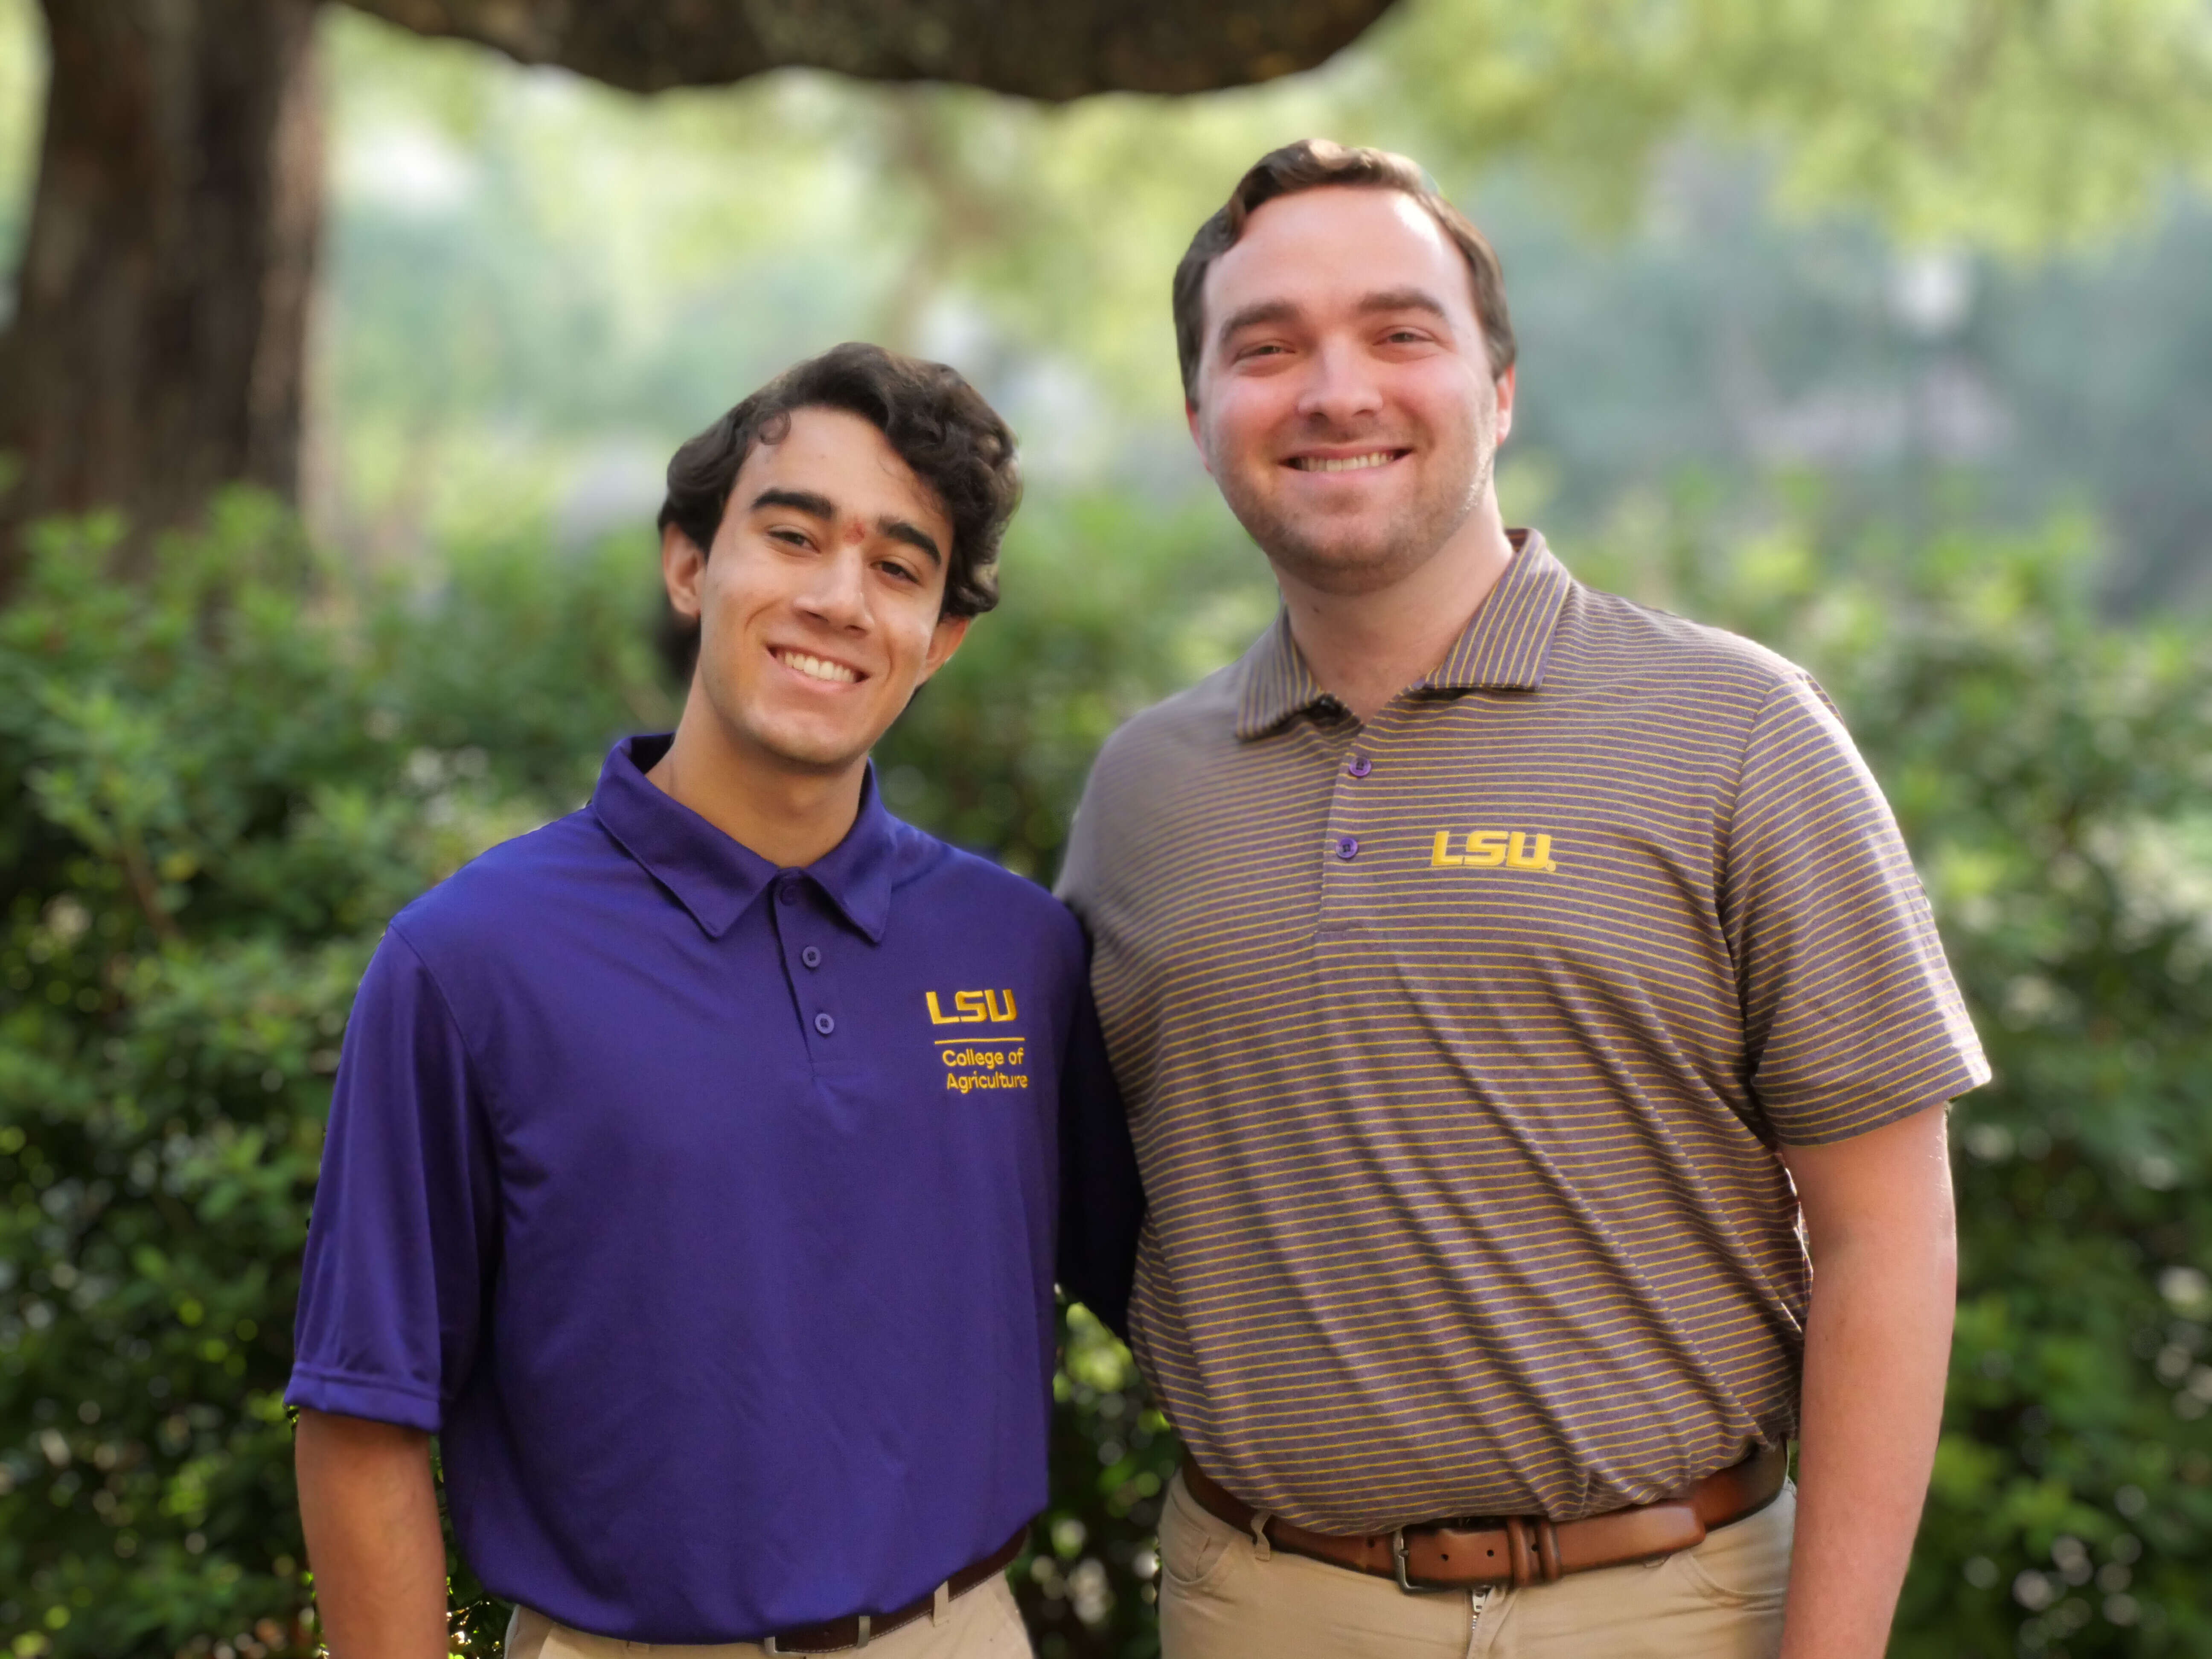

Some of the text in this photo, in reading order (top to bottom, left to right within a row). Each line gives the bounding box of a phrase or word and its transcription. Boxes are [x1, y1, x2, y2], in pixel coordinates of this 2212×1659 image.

[1431, 830, 1551, 869] LSU
[926, 989, 1017, 1025] LSU
[942, 1048, 1024, 1069] College of
[947, 1070, 1028, 1094] Agriculture
